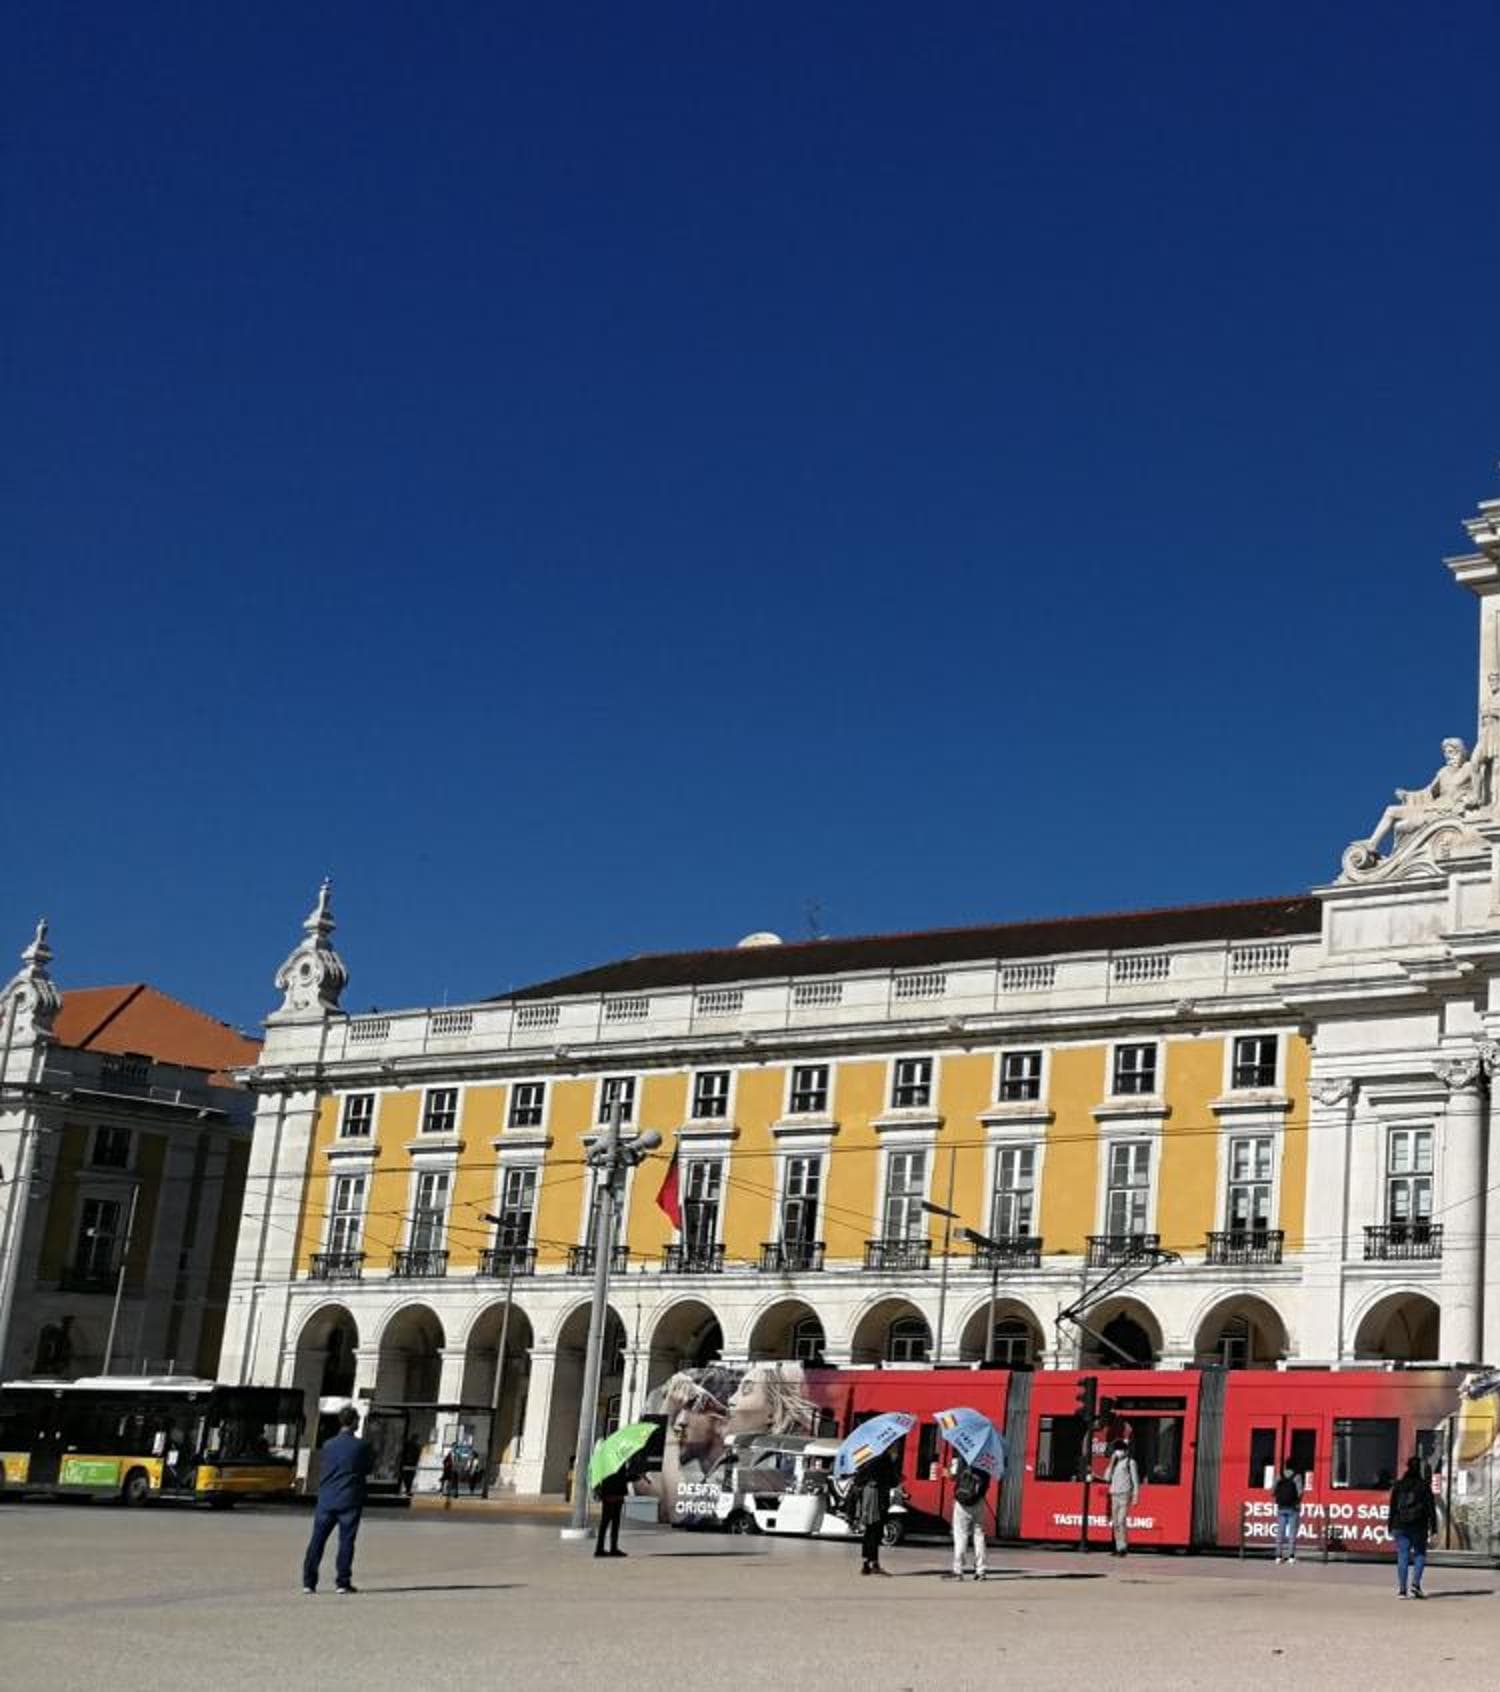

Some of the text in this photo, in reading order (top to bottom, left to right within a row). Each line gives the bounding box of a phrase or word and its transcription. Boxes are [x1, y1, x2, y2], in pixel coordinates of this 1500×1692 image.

[677, 1483, 719, 1497] DESFR
[1245, 1502, 1390, 1519] DESTA DO SAB
[1088, 1515, 1107, 1527] THE
[1108, 1517, 1153, 1529] LING
[1244, 1522, 1317, 1538] ORIGAL
